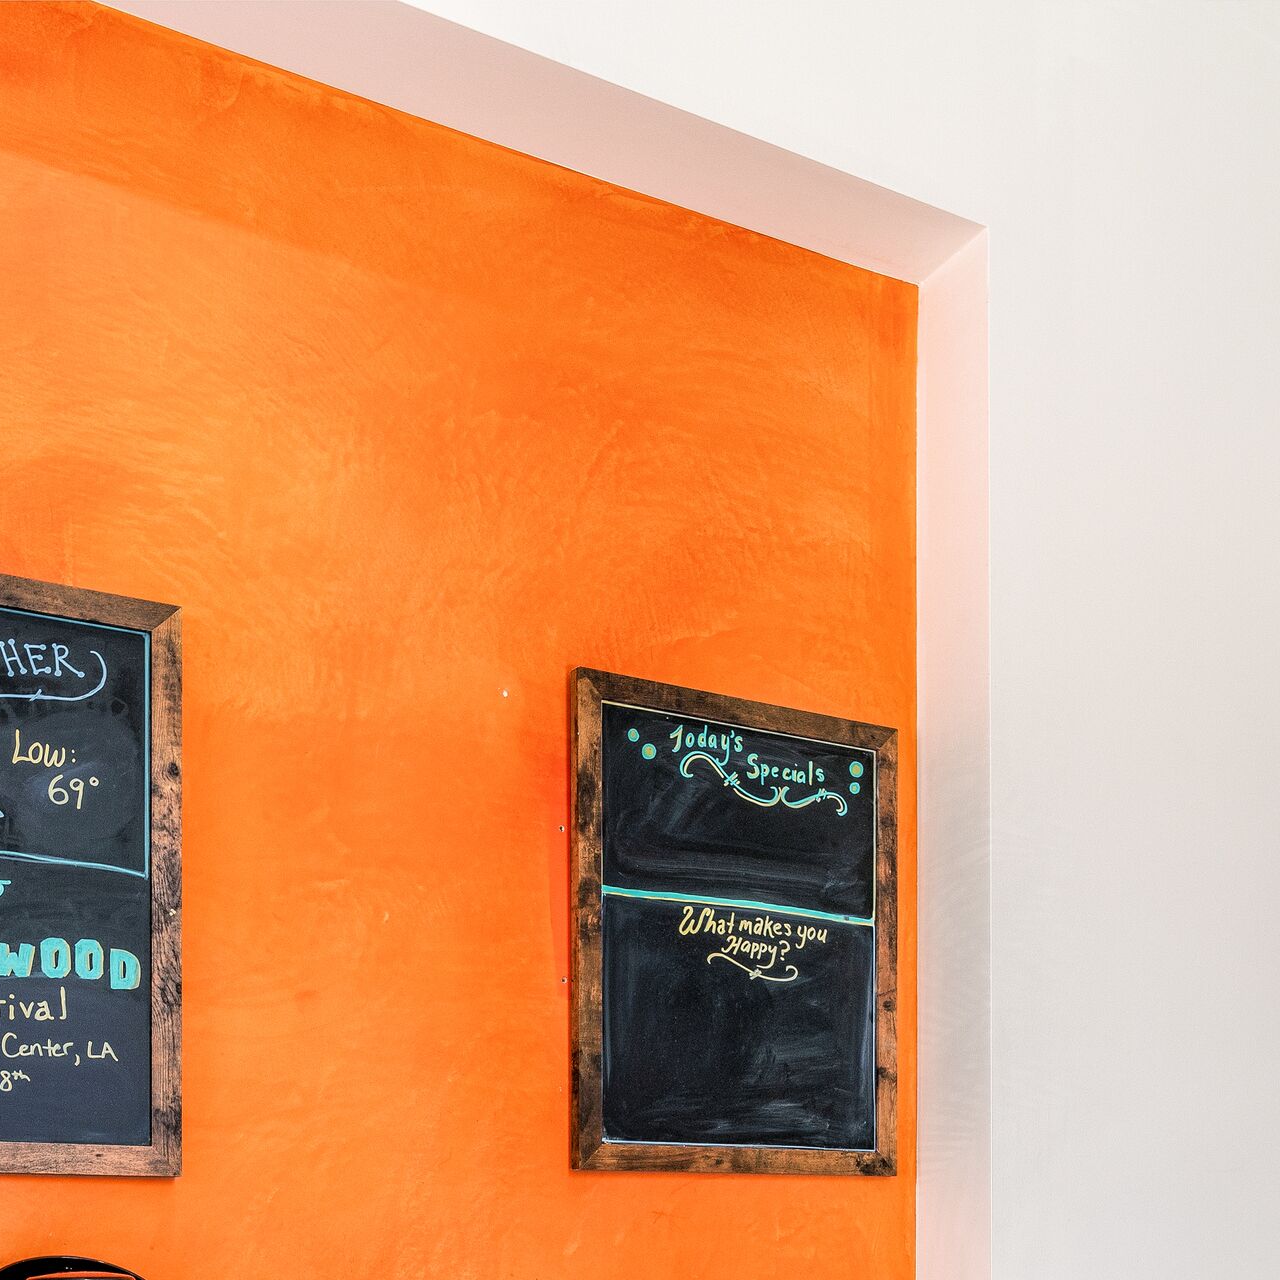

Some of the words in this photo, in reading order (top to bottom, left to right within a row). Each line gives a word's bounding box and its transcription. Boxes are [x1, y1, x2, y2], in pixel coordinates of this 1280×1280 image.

[669, 725, 743, 766] Today's
[746, 752, 825, 786] Specials
[678, 905, 735, 935] What
[738, 914, 794, 938] makes
[796, 926, 828, 950] you
[721, 936, 791, 968] Happy?
[1, 1031, 81, 1067] Center,
[86, 1040, 119, 1062] LA
